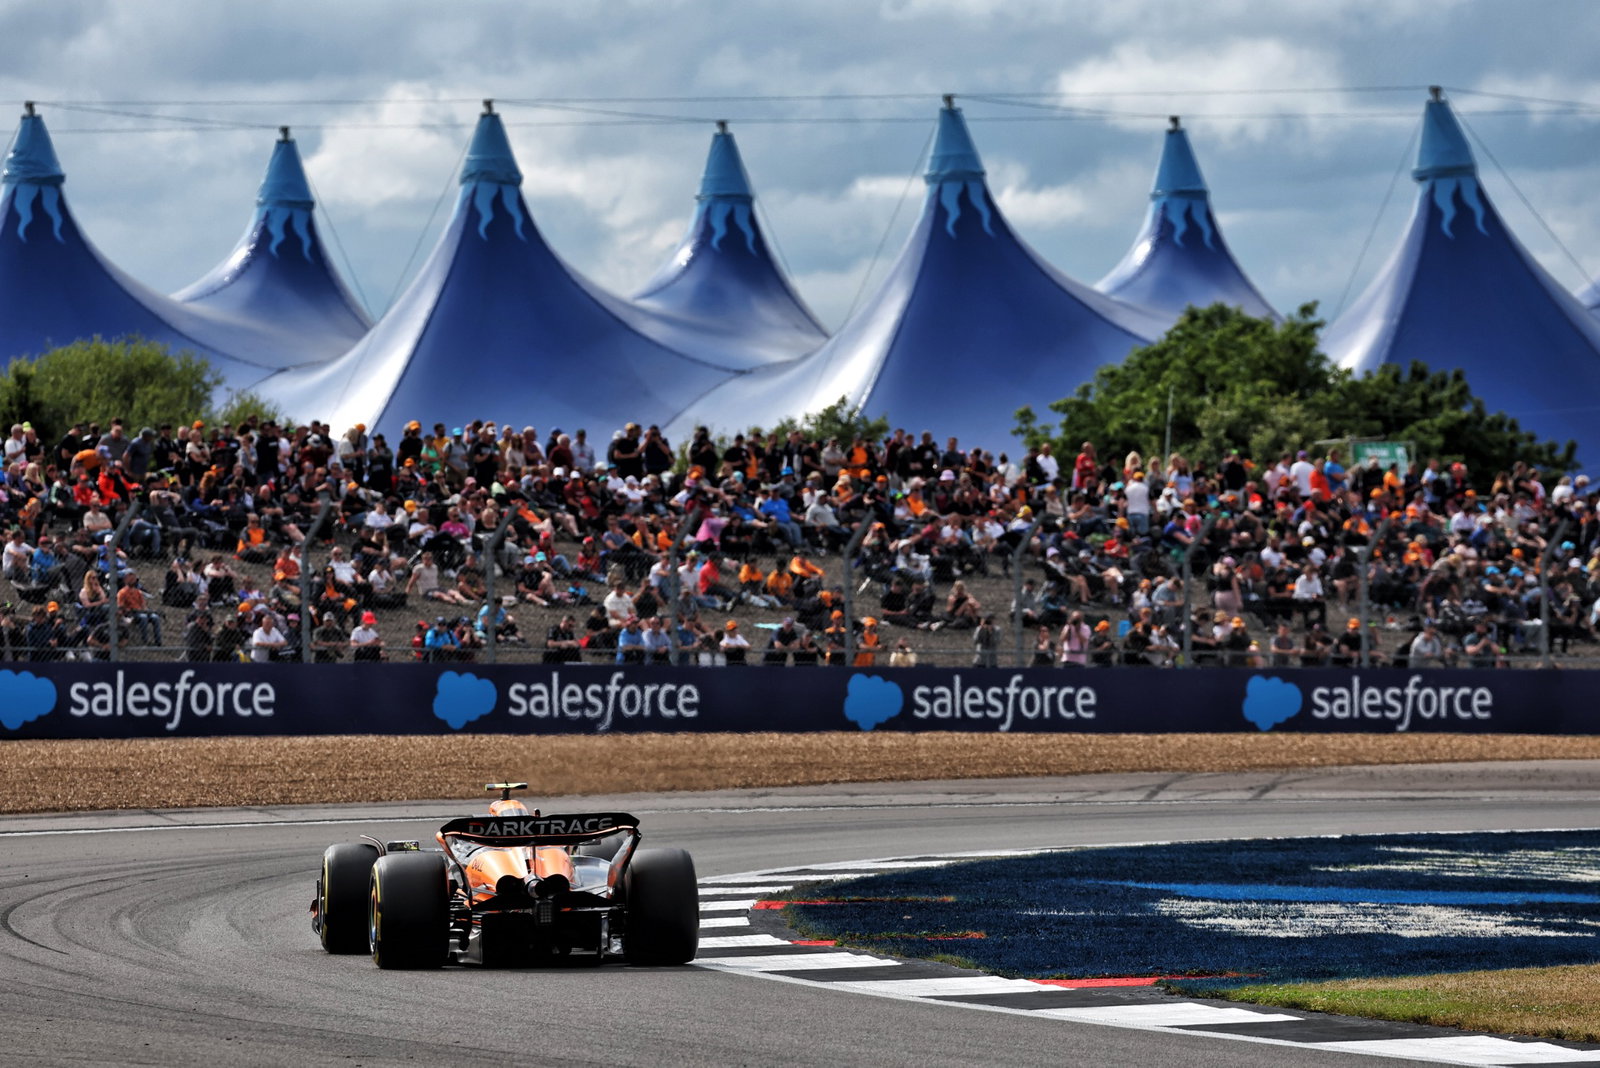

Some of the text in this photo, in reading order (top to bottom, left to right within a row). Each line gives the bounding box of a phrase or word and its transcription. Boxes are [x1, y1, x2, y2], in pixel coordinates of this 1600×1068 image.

[69, 669, 276, 731] salesforce
[507, 671, 699, 731] salesforce
[912, 674, 1097, 732] salesforce
[1311, 675, 1493, 731] salesforce
[469, 818, 613, 837] DARKTRACE
